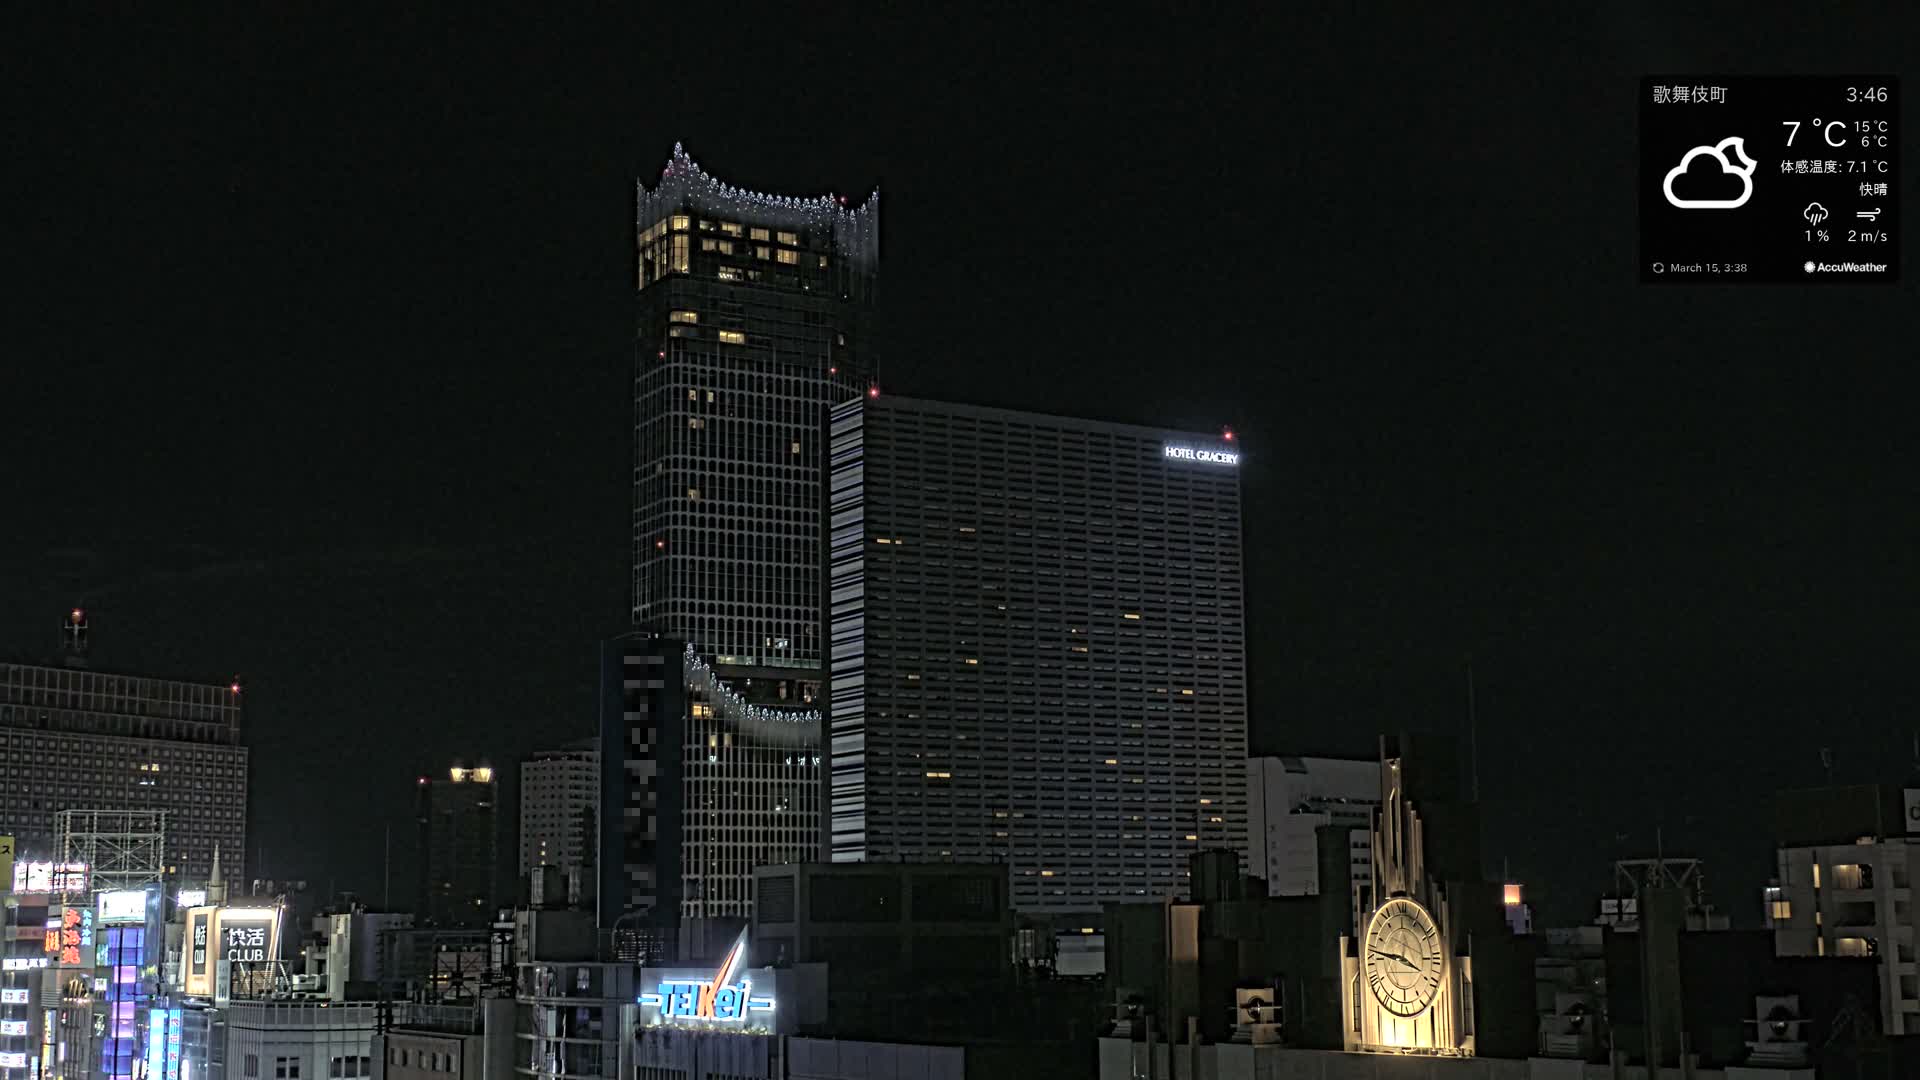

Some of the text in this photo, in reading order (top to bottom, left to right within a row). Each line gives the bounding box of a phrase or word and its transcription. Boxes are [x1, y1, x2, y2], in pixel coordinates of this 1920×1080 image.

[1165, 446, 1239, 464] HOTEL GRACERY
[228, 928, 264, 947] 快活
[228, 949, 264, 962] CLUB
